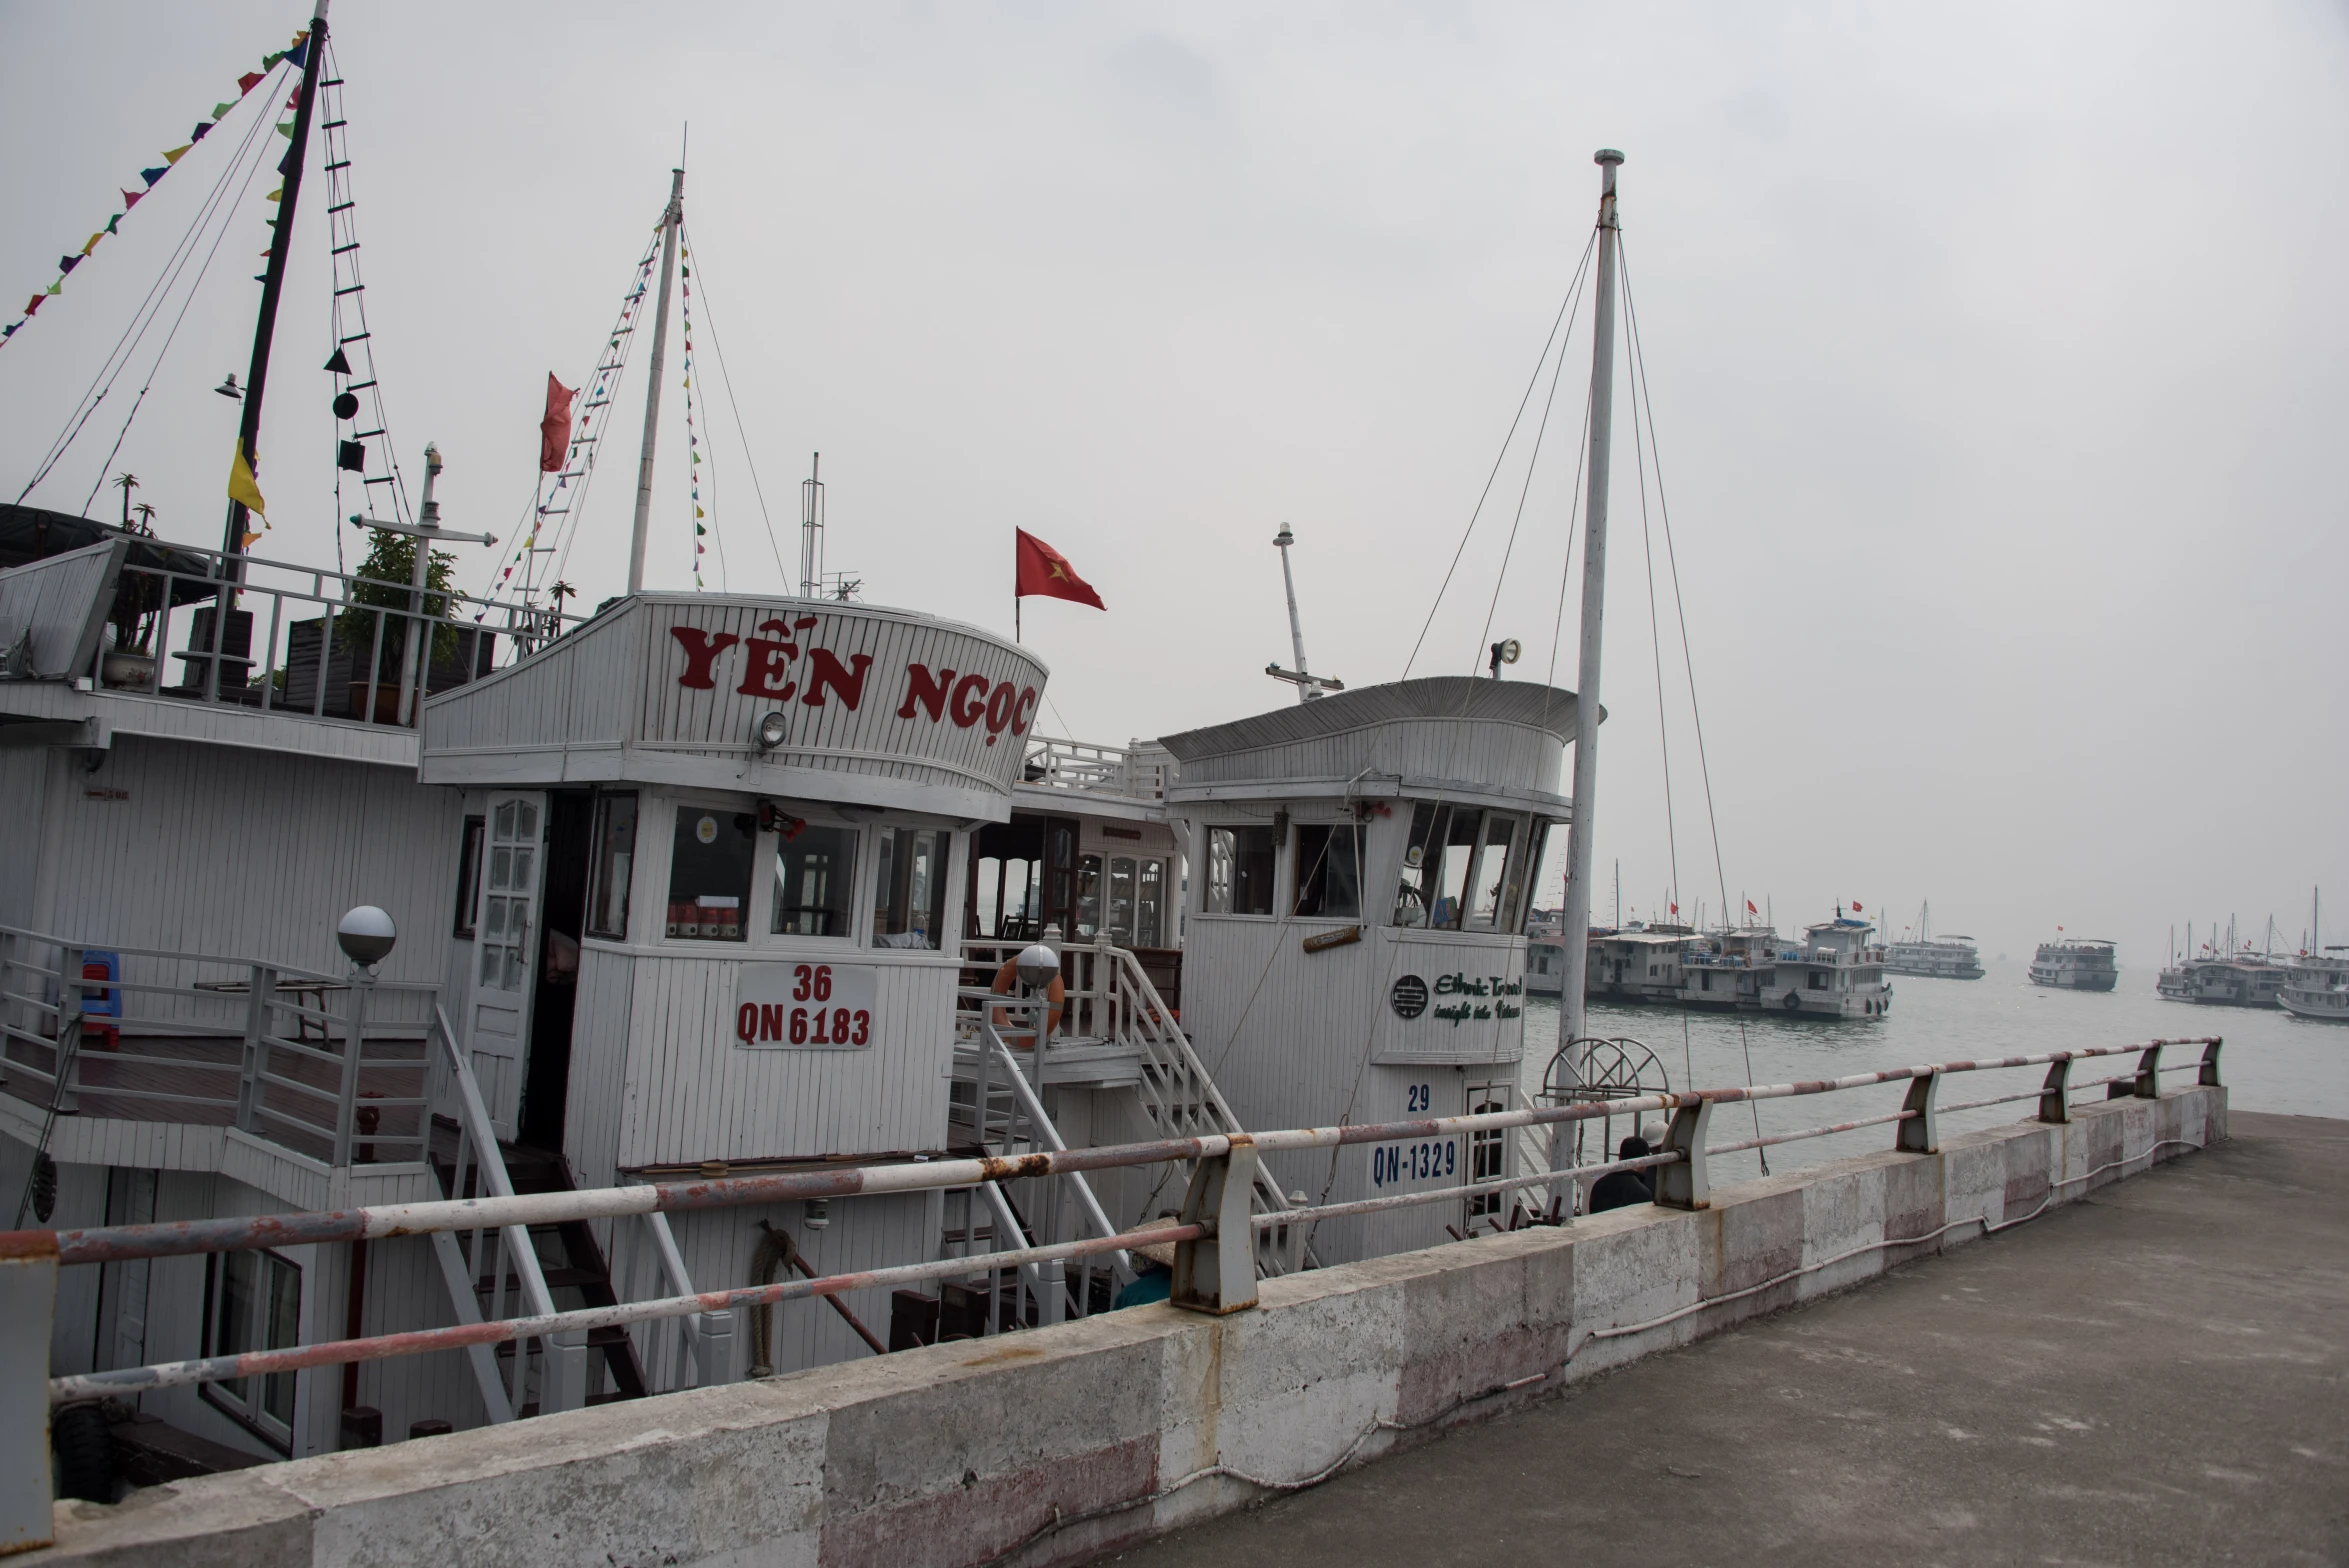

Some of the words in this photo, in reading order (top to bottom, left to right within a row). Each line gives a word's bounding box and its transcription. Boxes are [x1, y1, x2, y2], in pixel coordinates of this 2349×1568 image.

[670, 617, 872, 711] YẾN
[898, 664, 1036, 746] NGỌC
[793, 964, 832, 1002] 36
[1433, 972, 1489, 996] Ethnic
[1489, 975, 1522, 996] Travel
[737, 1002, 783, 1045] QN
[789, 1007, 870, 1046] 6183
[1408, 1083, 1430, 1112] 29
[1373, 1141, 1455, 1188] QN-1329
